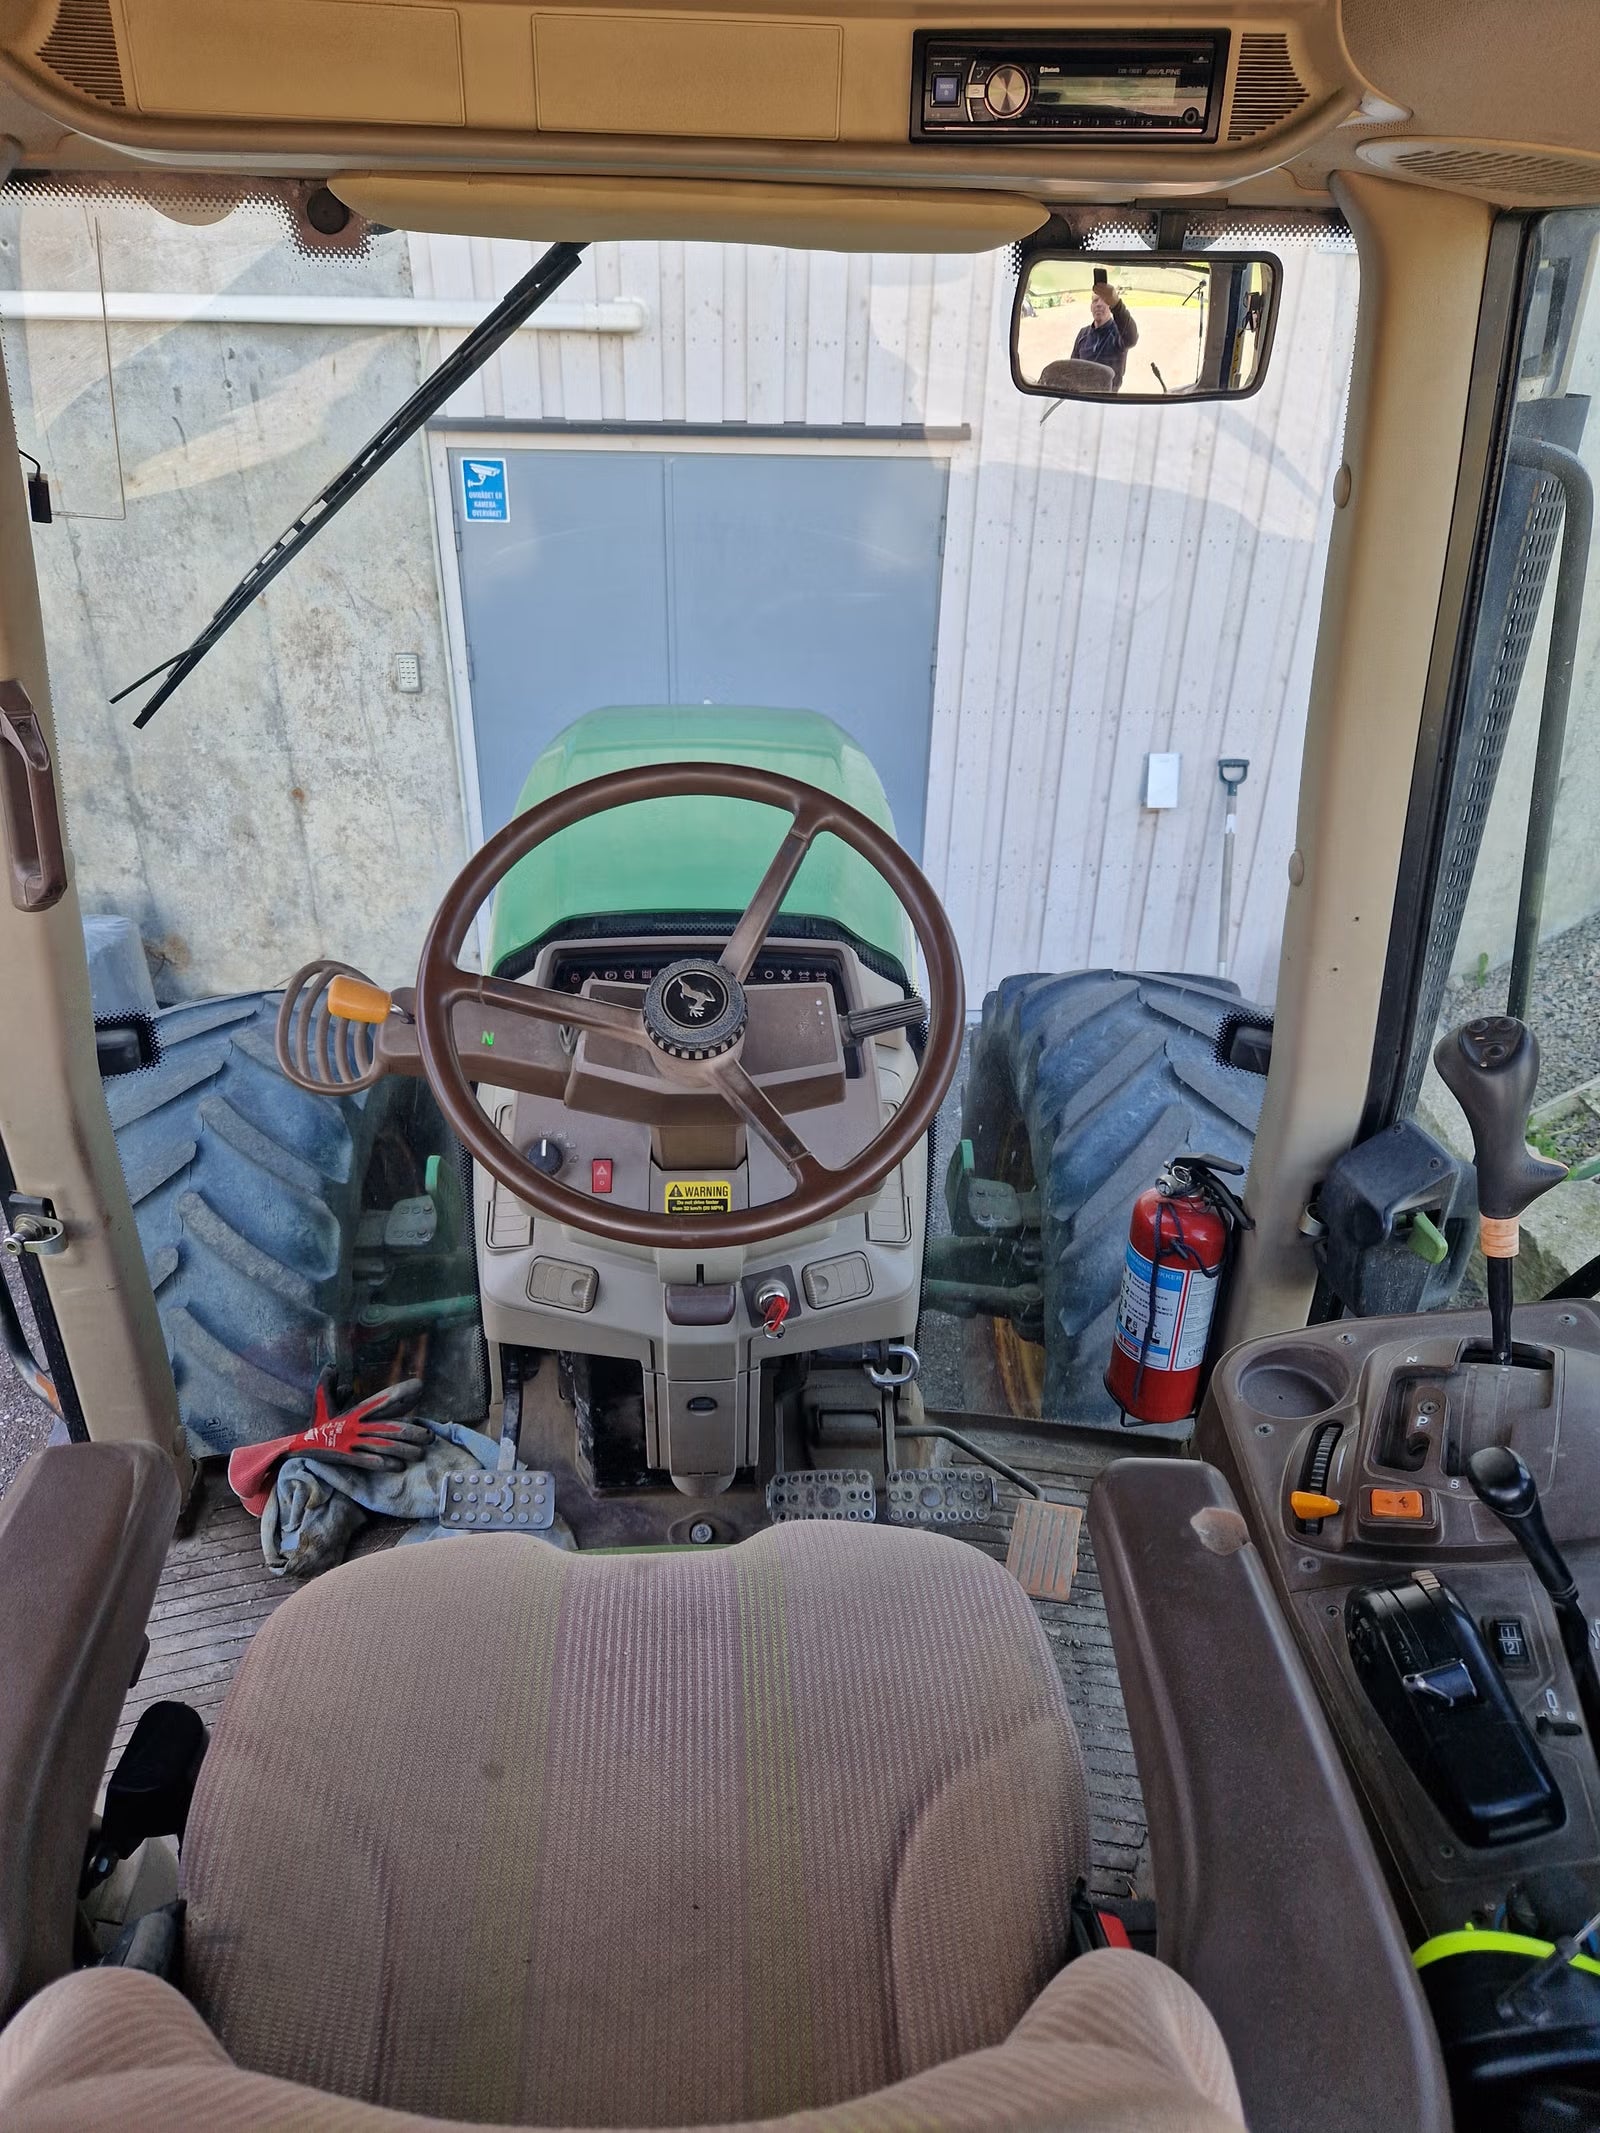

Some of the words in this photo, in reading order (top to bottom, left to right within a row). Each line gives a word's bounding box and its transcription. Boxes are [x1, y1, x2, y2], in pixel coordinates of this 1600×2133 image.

[481, 1030, 495, 1046] N
[685, 1186, 728, 1197] WARNING
[1406, 1355, 1417, 1363] N
[1416, 1416, 1429, 1427] P
[1505, 1628, 1511, 1638] 1
[1507, 1641, 1517, 1654] 2
